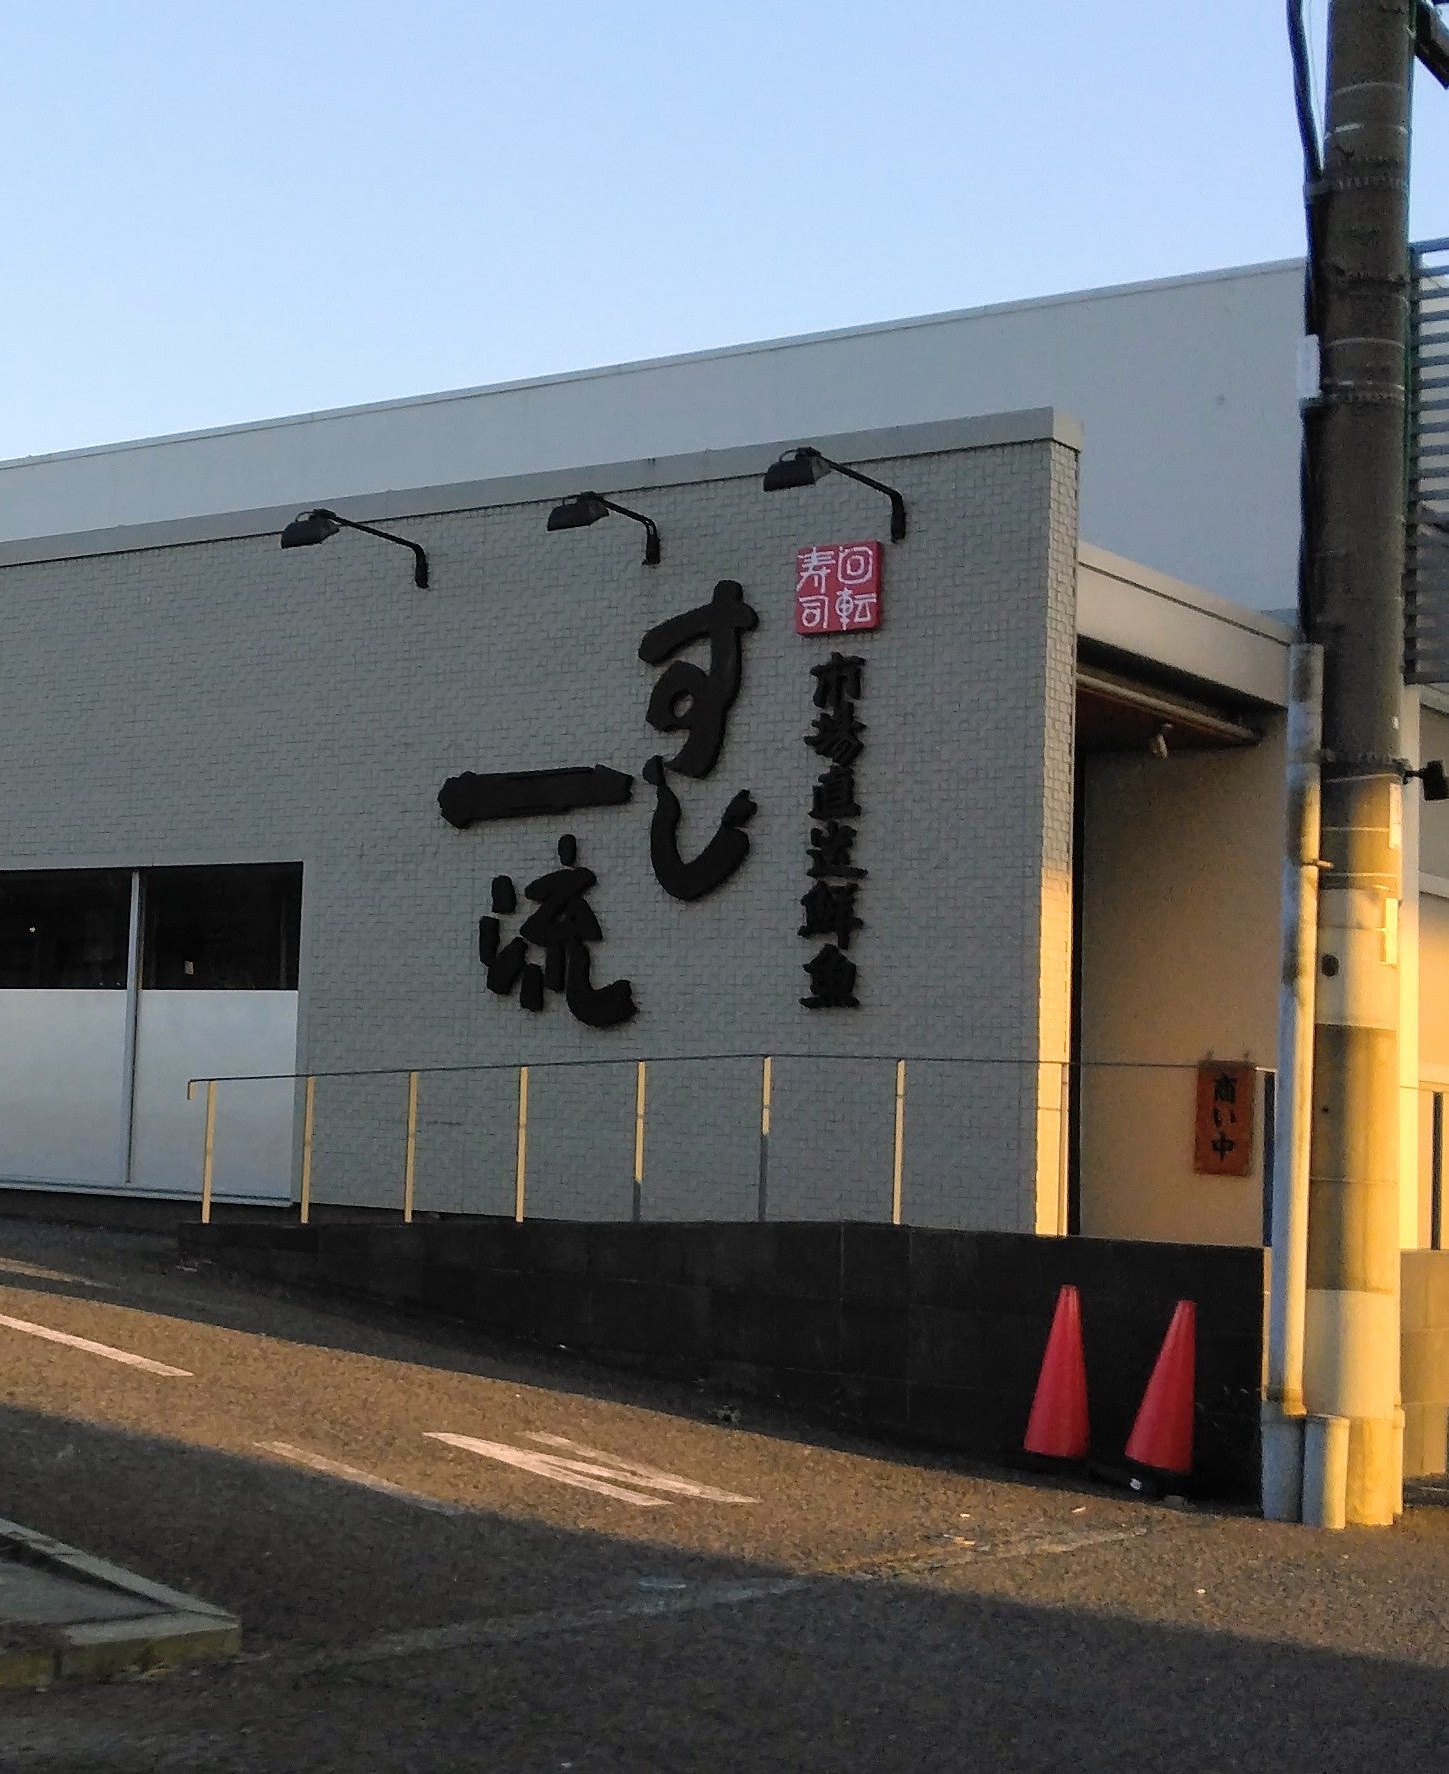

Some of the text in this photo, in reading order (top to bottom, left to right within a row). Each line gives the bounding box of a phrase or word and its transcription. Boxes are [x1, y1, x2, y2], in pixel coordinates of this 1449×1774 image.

[796, 546, 836, 629] 寿司
[835, 546, 877, 631] 回転
[638, 580, 759, 900] すし
[438, 764, 638, 1028] 一流
[798, 651, 868, 1008] 市場直送鮮魚
[1211, 1072, 1237, 1161] 商い中
